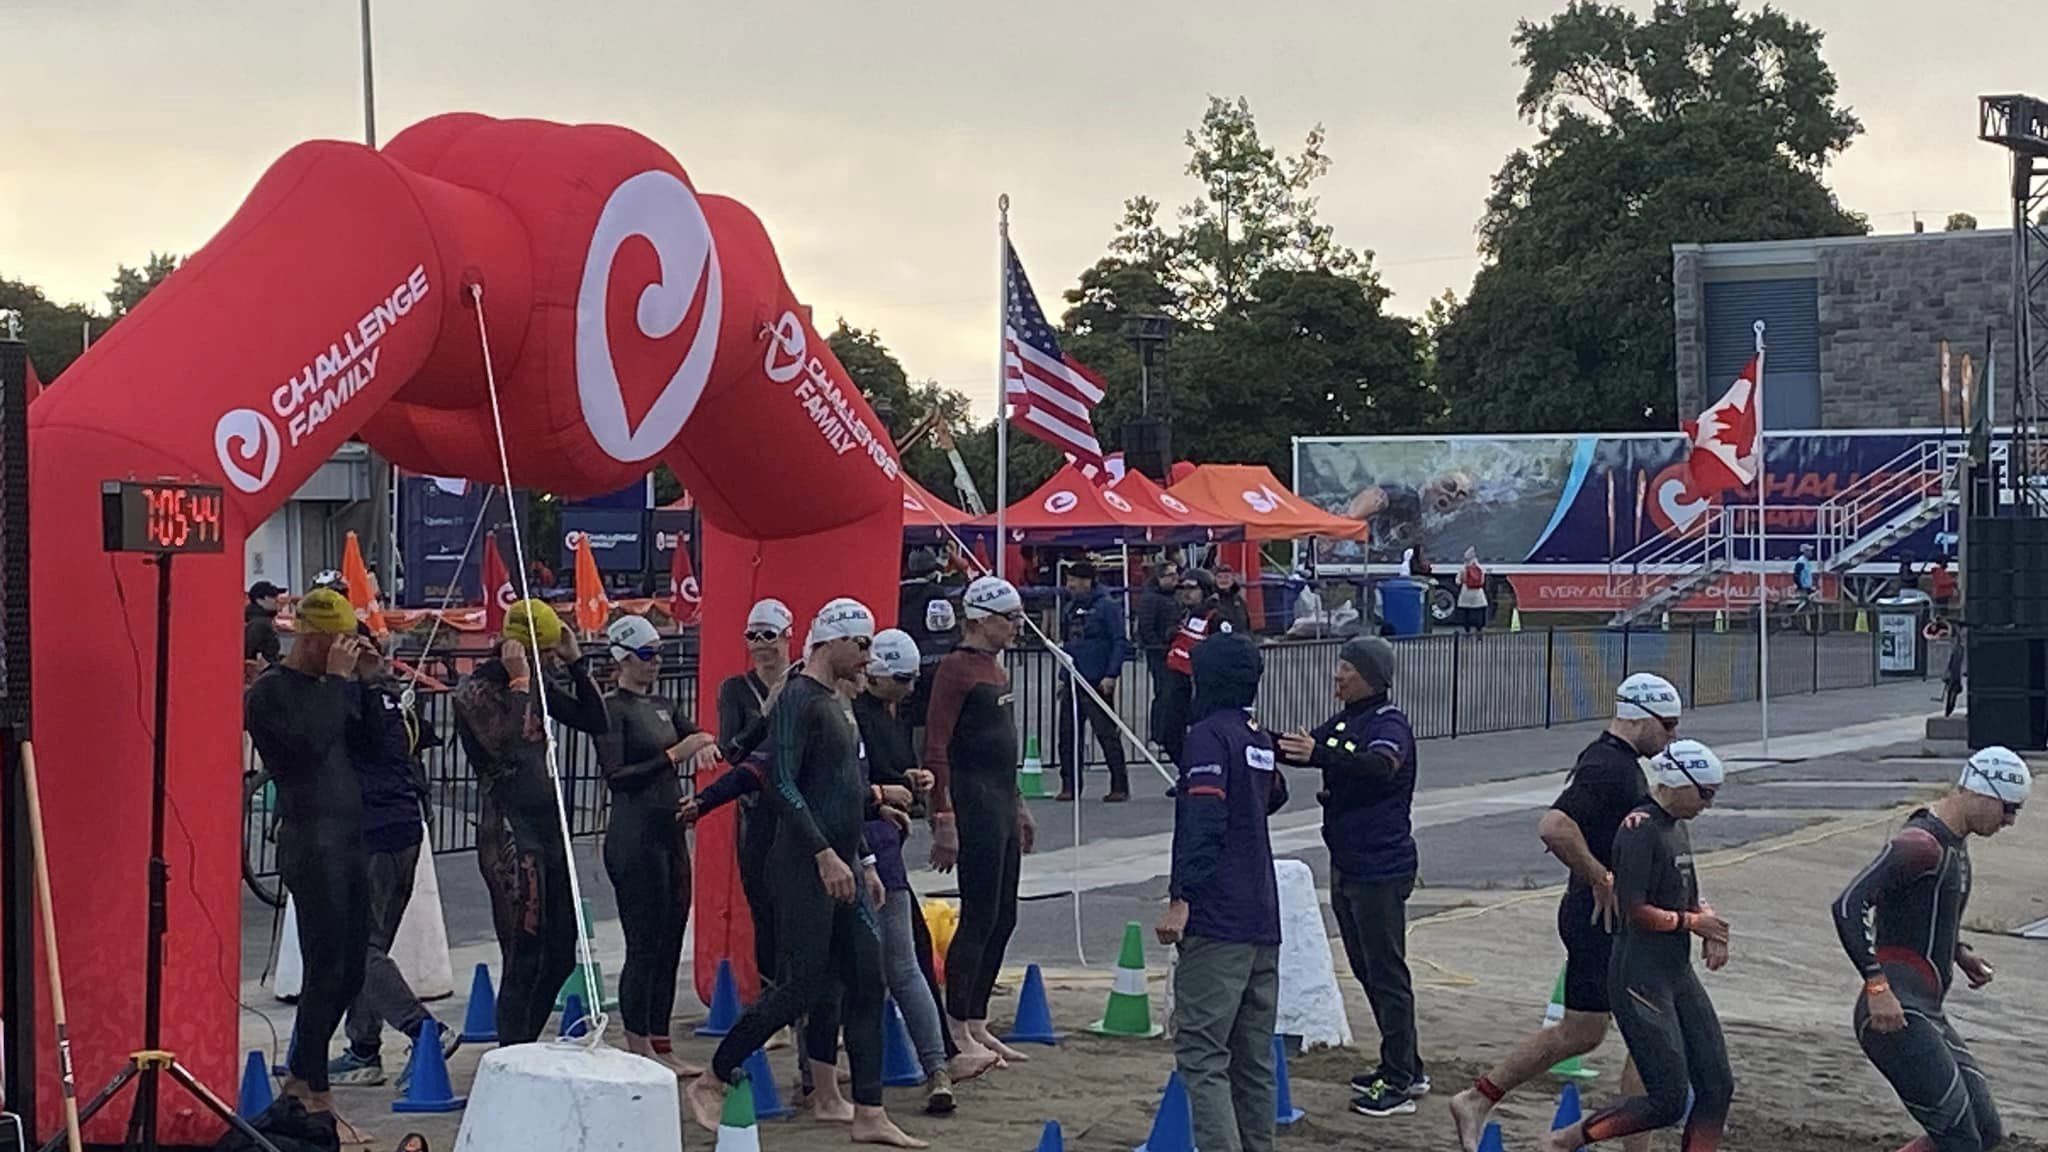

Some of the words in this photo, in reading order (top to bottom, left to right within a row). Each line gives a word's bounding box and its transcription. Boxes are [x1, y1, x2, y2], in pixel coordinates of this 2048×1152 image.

[271, 263, 429, 417] CHALLENGE
[288, 346, 380, 447] FAMILY
[793, 378, 857, 455] FAMILY
[806, 356, 899, 480] CHALLENGE
[1539, 585, 1586, 598] EVERY
